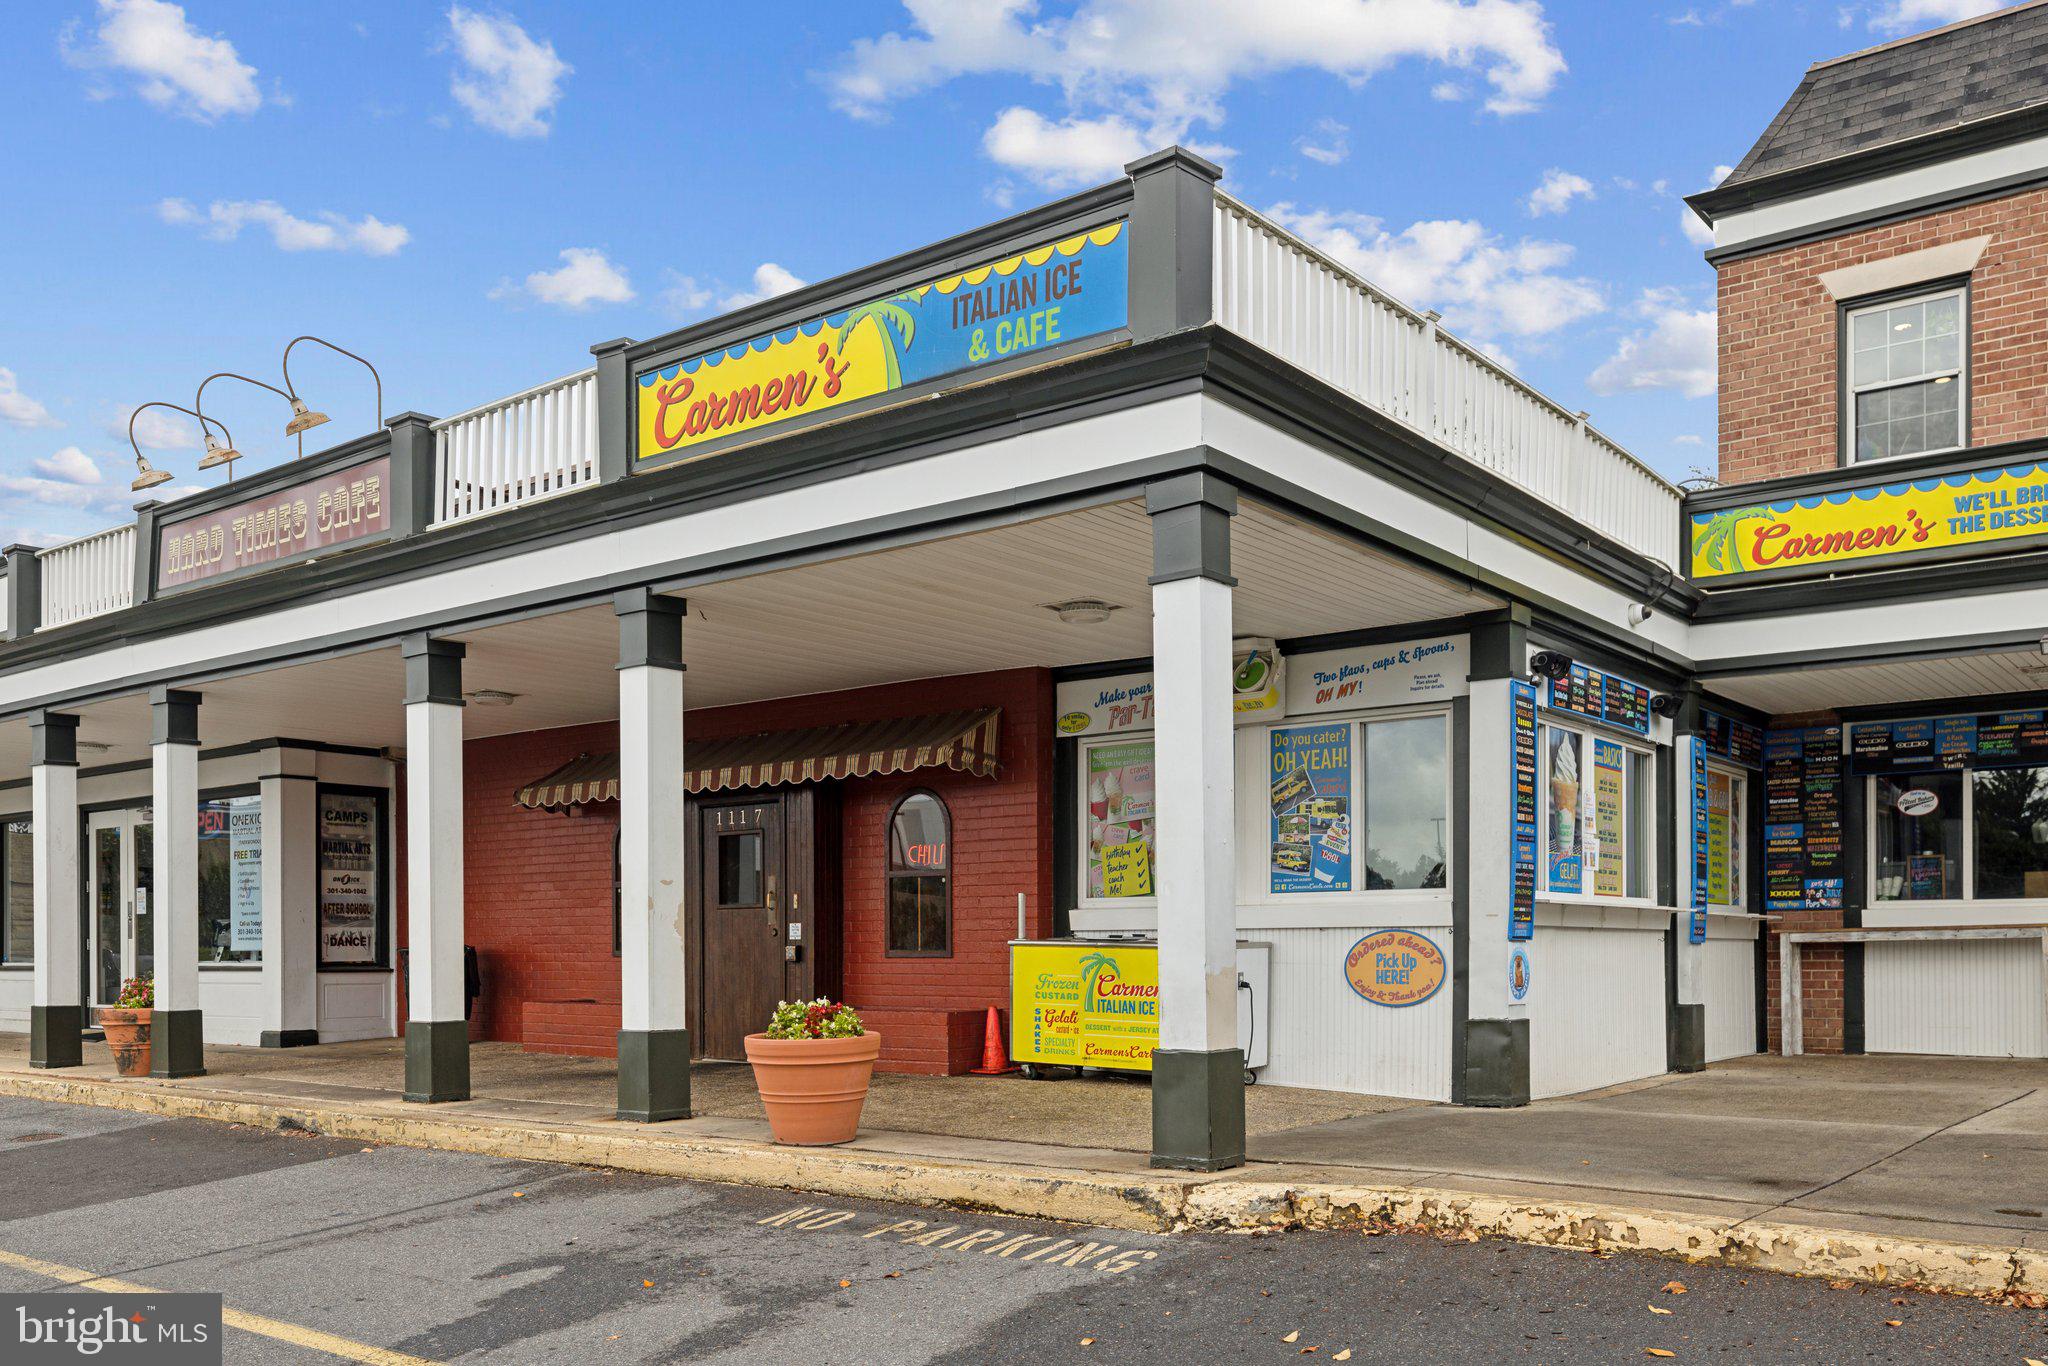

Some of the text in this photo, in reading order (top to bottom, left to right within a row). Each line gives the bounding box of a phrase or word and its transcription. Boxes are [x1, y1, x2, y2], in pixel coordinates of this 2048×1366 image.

[952, 259, 1083, 330] ITALIAN ICE
[968, 311, 1061, 362] & CAFE
[654, 342, 850, 449] Carmen's
[1954, 490, 2012, 513] WE'LL
[168, 475, 381, 575] HARD TIMES CAFE
[1947, 514, 1985, 535] THE
[1751, 508, 1937, 566] Carmen's
[1313, 671, 1337, 686] Two
[1372, 655, 1396, 670] cups
[1398, 650, 1410, 664] &
[1094, 688, 1127, 708] Make
[1315, 680, 1363, 704] OH MY!
[1275, 728, 1346, 749] Do you cater?
[1273, 746, 1348, 773] OH YEAH!
[1603, 745, 1622, 769] BASICS
[198, 811, 224, 832] PEN
[325, 809, 368, 823] CAMPS
[716, 808, 762, 826] 1117
[234, 850, 248, 860] FREE
[322, 840, 371, 855] MARTIAL ARTS
[908, 843, 945, 866] CHILI
[323, 902, 371, 915] AFTER SCHOOL
[237, 928, 262, 936] 301-340-104
[330, 936, 367, 947] DANCE
[1348, 933, 1395, 968] Ordered
[1375, 953, 1417, 972] Pick Up
[1036, 974, 1079, 990] Frozen
[1375, 969, 1410, 985] HERE!
[1035, 991, 1079, 1000] CUSTARD
[1355, 979, 1376, 997] Enjoy
[1388, 989, 1416, 1001] Thank
[1045, 1008, 1079, 1027] Gelati
[1097, 999, 1155, 1015] ITALIAN ICE
[1044, 1038, 1075, 1047] SPECIALTY
[756, 1207, 1158, 1273] NO PARKING
